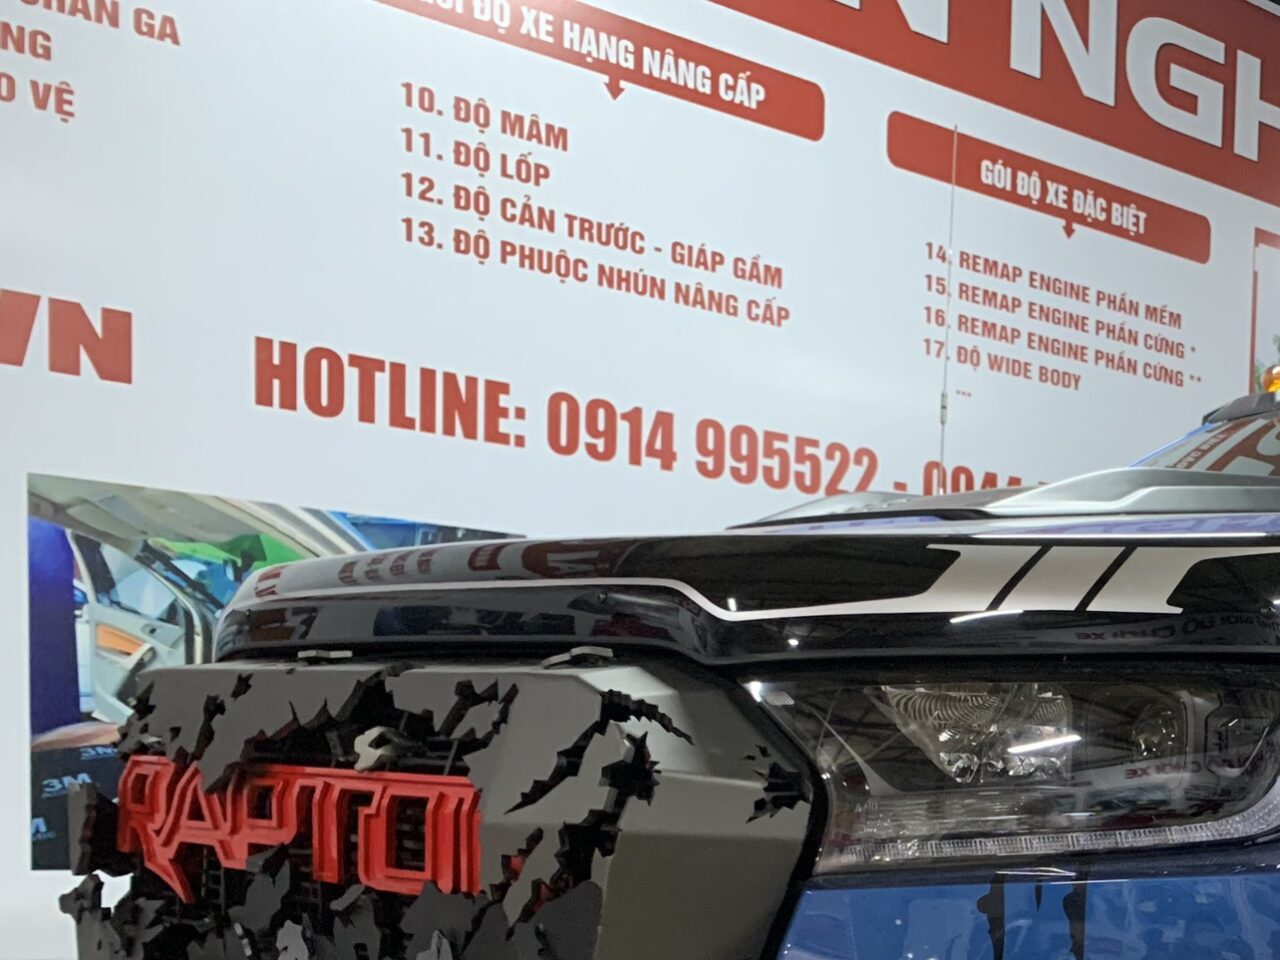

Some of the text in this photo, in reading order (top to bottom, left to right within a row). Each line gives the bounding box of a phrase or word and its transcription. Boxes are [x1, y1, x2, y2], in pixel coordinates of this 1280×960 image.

[133, 7, 180, 46] GA
[520, 6, 554, 43] XE
[563, 20, 635, 70] HẠNG
[642, 47, 713, 95] NÂNG
[718, 71, 766, 110] CẤP
[30, 80, 76, 123] VỆ
[400, 82, 568, 151] 10. ĐỘ MÂM
[400, 127, 550, 187] 11. ĐỘ LỐP
[400, 172, 444, 205] 12.
[453, 184, 491, 221] ĐỘ
[500, 195, 555, 233] CẢN
[564, 212, 645, 255] TRƯỚC
[671, 241, 725, 274] GIÁP
[980, 159, 1147, 237] GÓI ĐỘ XE ĐẶC BIỆT
[400, 217, 790, 328] 13. ĐỘ PHUỘC NHÚN NÂNG CẤP
[959, 251, 1023, 284] REMAP
[1028, 270, 1090, 304] ENGINE
[958, 282, 1021, 315] REMAP
[1027, 302, 1089, 334] ENGINE
[956, 345, 981, 372] ĐỘ
[987, 353, 1033, 381] WIDE
[1038, 366, 1082, 391] BODY
[957, 314, 1020, 347] REMAP
[1027, 332, 1088, 365] ENGINE
[255, 336, 526, 448] HOTLINE:
[546, 391, 677, 472] 0914
[695, 418, 878, 497] 995522
